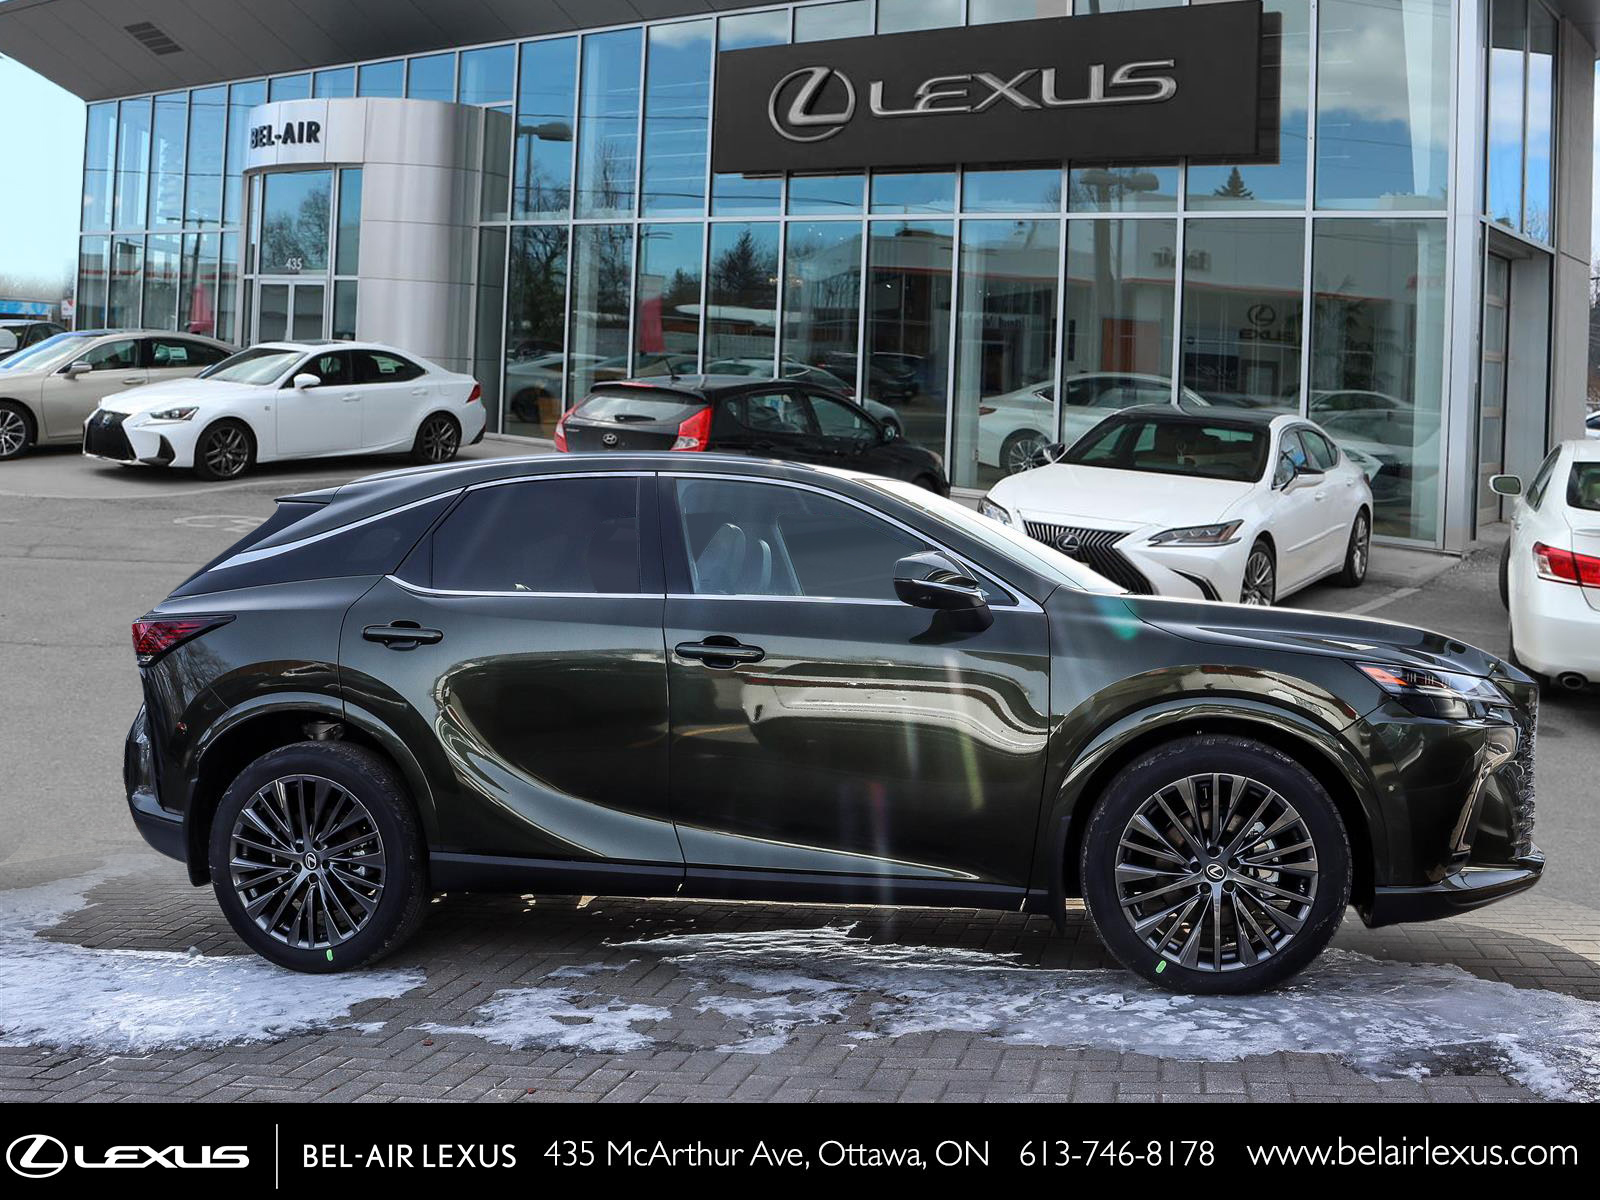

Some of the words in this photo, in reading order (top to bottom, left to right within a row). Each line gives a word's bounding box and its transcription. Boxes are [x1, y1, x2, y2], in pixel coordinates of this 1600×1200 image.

[869, 59, 1178, 118] LEXUS
[250, 120, 321, 149] BEL-AIR
[285, 257, 303, 270] 435
